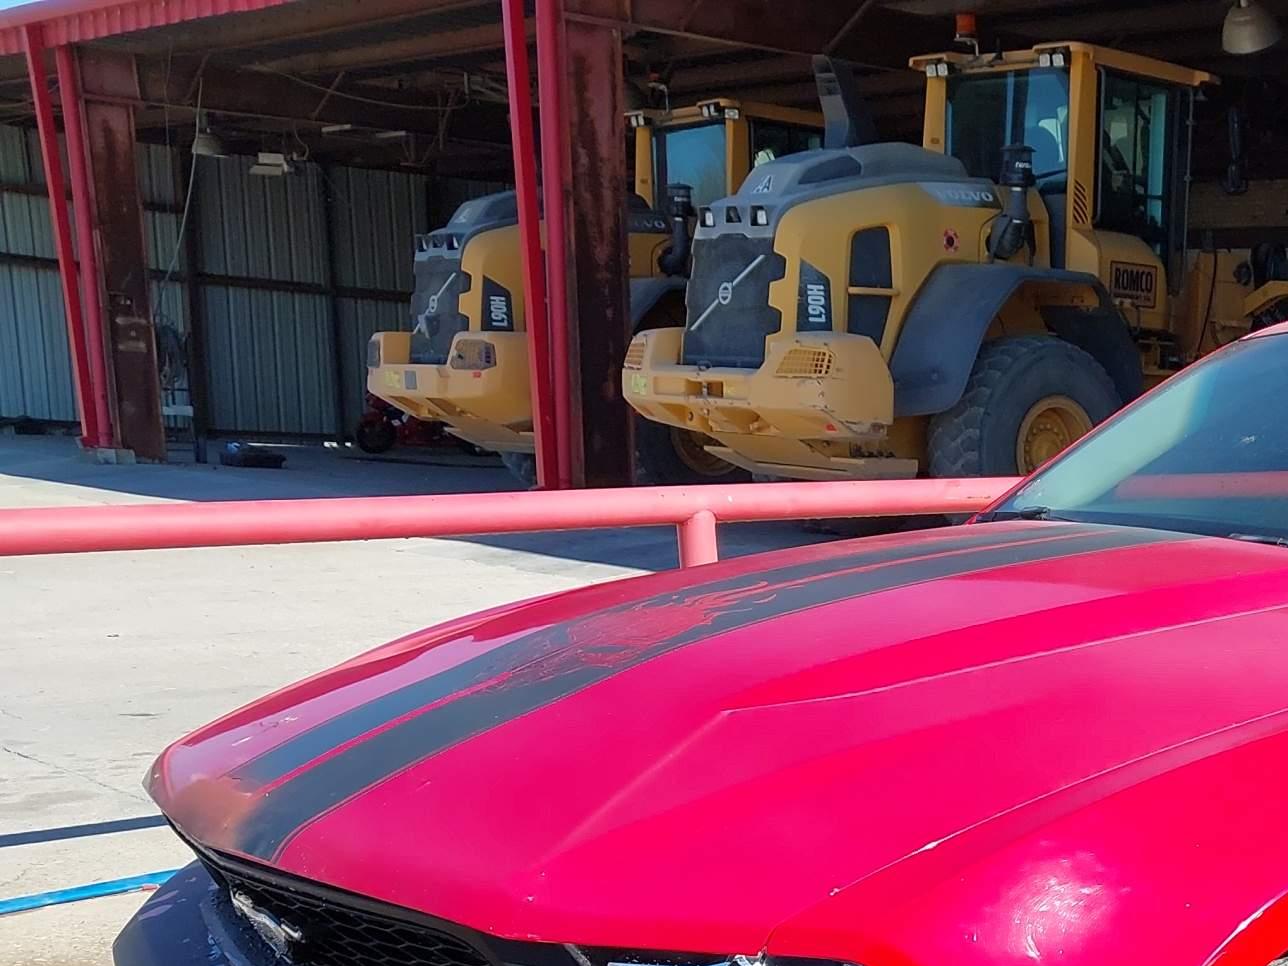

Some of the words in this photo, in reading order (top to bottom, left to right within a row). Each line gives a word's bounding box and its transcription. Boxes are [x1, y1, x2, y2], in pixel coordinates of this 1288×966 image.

[1114, 267, 1153, 293] ROMCO
[490, 296, 508, 327] L90H
[807, 284, 826, 322] L90H
